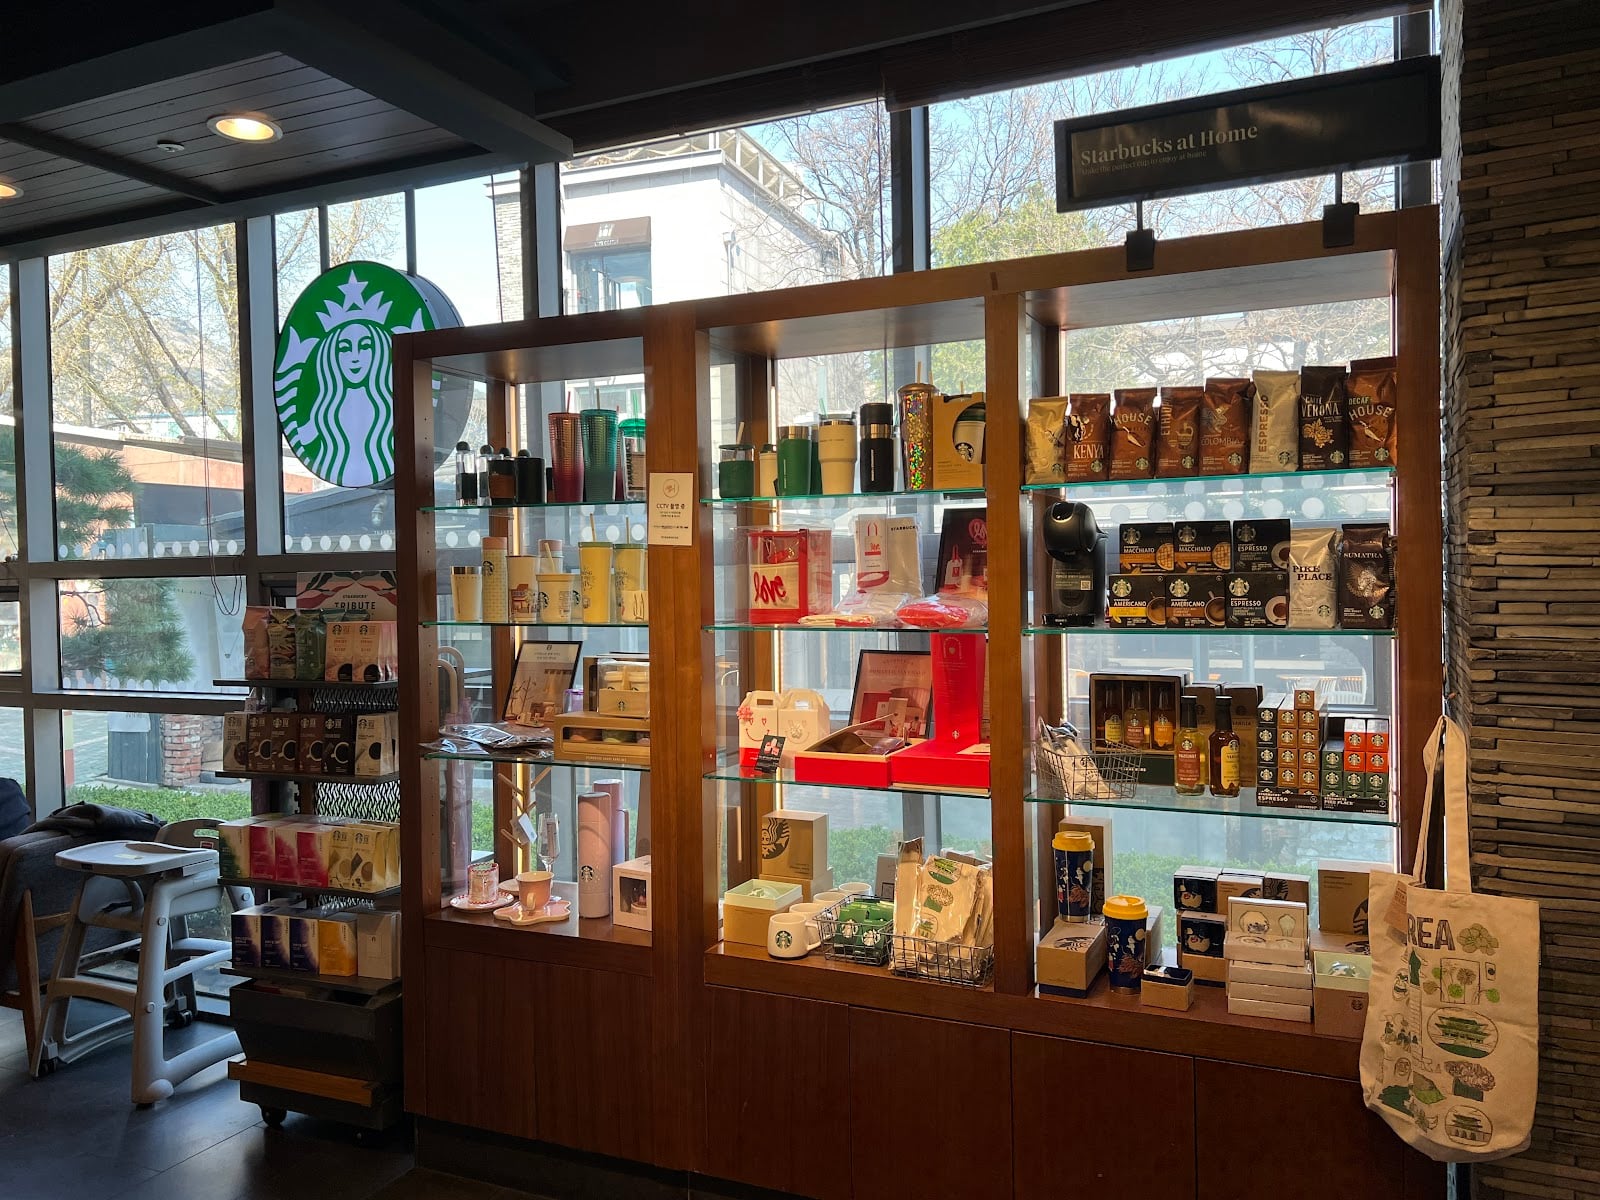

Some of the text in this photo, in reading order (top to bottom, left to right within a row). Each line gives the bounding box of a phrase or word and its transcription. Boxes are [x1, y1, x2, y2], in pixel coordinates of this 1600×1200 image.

[1081, 126, 1258, 166] Starbucks at Home
[1099, 165, 1111, 173] the
[1112, 161, 1136, 174] perfect
[1137, 160, 1149, 169] cup
[1158, 155, 1178, 165] enjoy
[1179, 153, 1186, 161] at
[1187, 150, 1207, 159] home
[1349, 397, 1369, 405] DECAF
[1301, 402, 1340, 418] VERONA
[1349, 405, 1395, 421] HOUSE
[1114, 412, 1153, 427] HOUSE
[1258, 395, 1269, 453] ESPRESSO
[1073, 443, 1104, 460] KENYA
[1292, 565, 1321, 573] PIKE
[1297, 573, 1333, 581] PLACE
[753, 571, 786, 605] love
[335, 602, 376, 610] TRIBUTE
[1257, 795, 1289, 803] ESPRESSO
